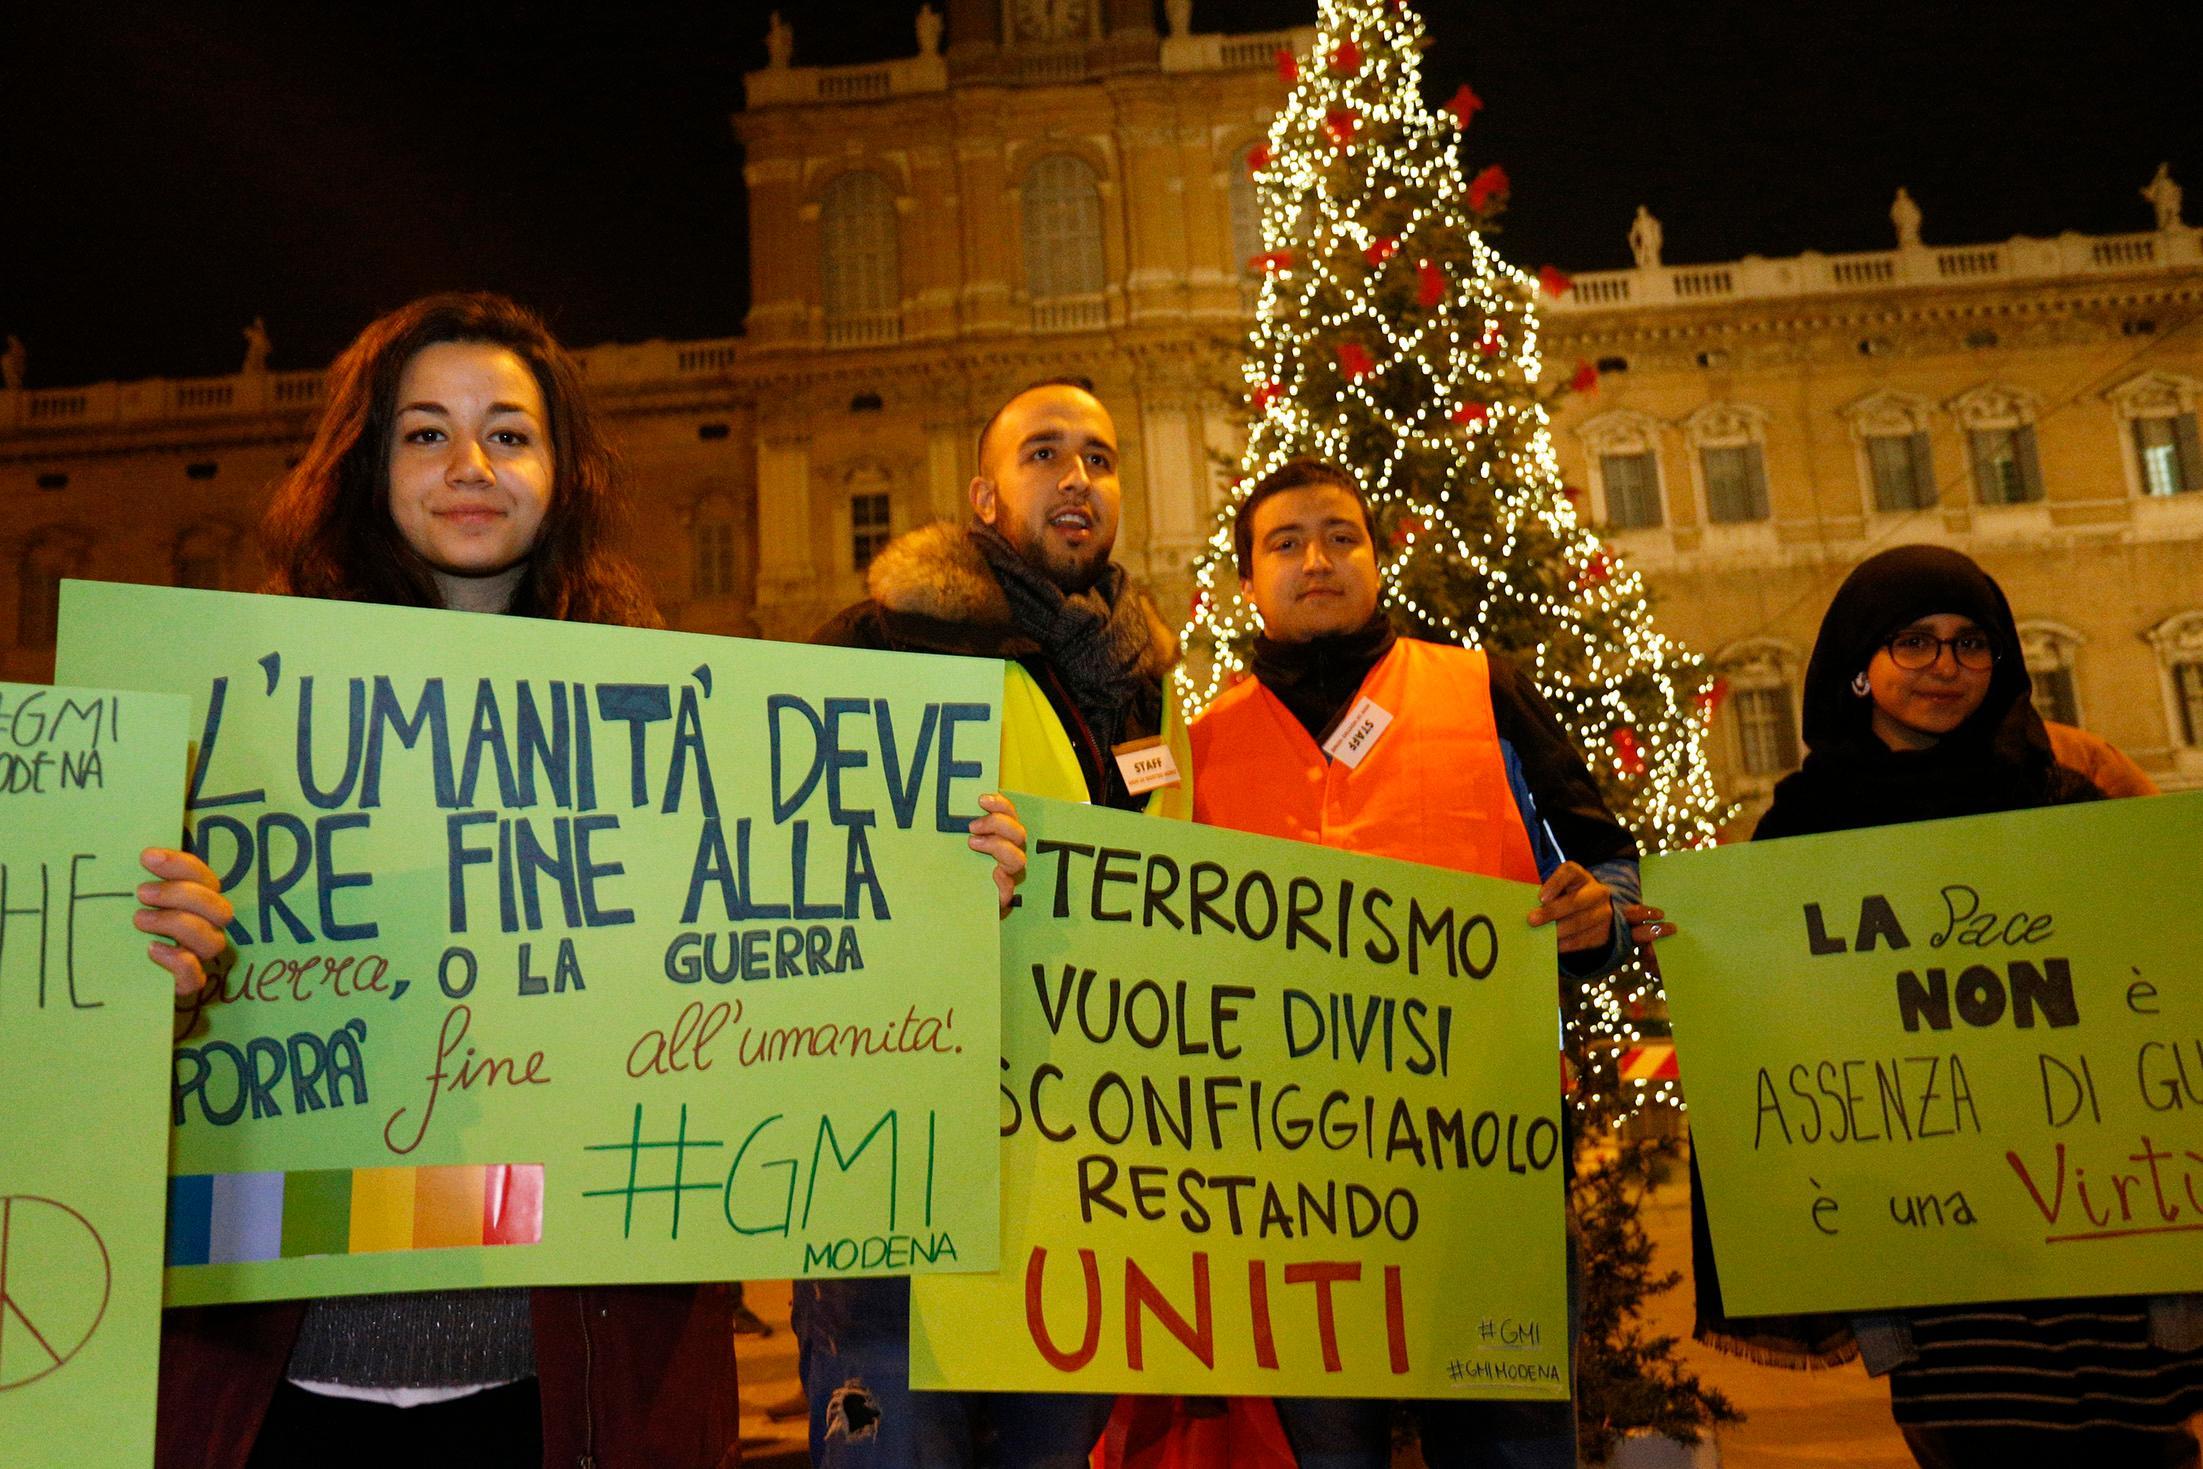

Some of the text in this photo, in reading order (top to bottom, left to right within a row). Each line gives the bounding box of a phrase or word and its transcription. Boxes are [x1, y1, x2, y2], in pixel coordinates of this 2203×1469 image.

[767, 693, 991, 834] DEVE
[1133, 757, 1162, 774] STAFF
[1344, 719, 1375, 752] STAFF
[182, 810, 892, 946] RRE FINE ALLA
[1035, 839, 1499, 981] TERRORISMO
[1803, 884, 2055, 956] LA Pace
[438, 946, 478, 999] O
[518, 937, 587, 997] LA
[664, 925, 865, 984] GUERRA
[1896, 957, 2161, 1032] NON è
[1032, 964, 1453, 1077] VUOLE DIVISI
[384, 1004, 551, 1154] fine
[1754, 1054, 1981, 1150] ASSENZA
[2039, 1053, 2101, 1127] DI
[582, 1103, 936, 1240] #GMI
[1077, 1154, 1420, 1242] RESTANDO
[1809, 1177, 1839, 1235] è
[1889, 1190, 1978, 1228] una
[802, 1232, 957, 1273] MODENA
[1025, 1245, 1410, 1374] UNITI
[1478, 1317, 1541, 1345] #GMI
